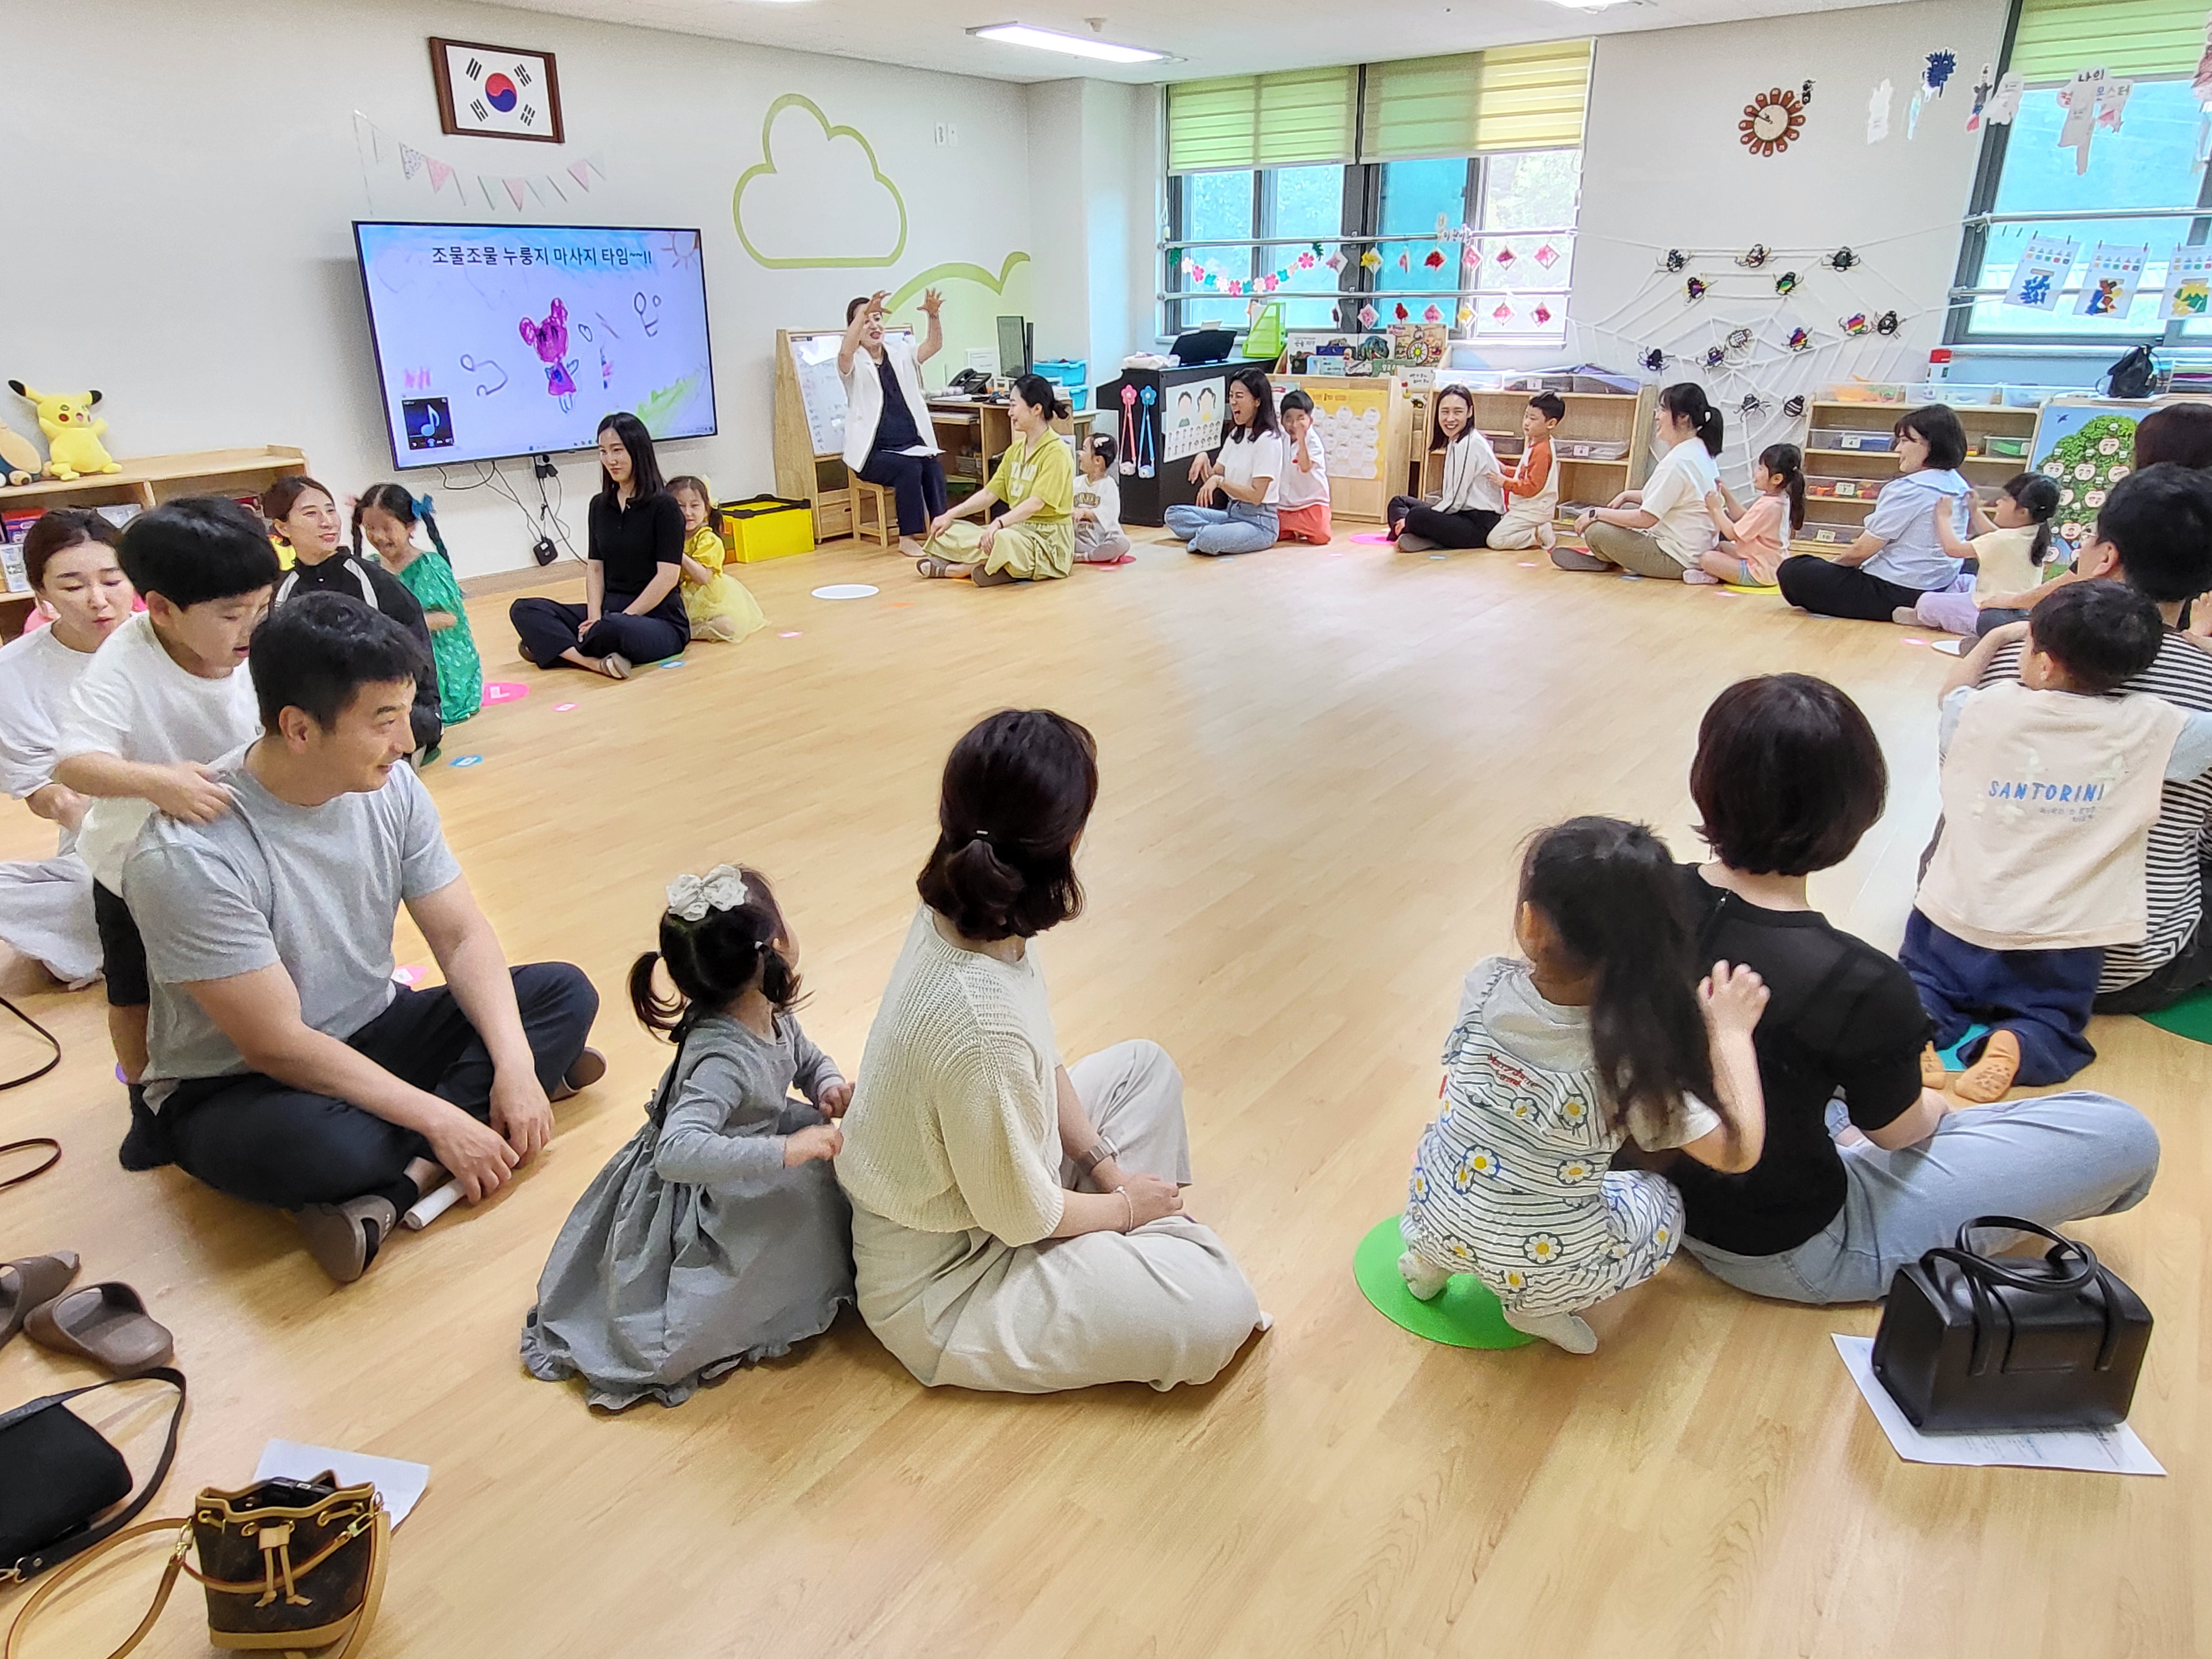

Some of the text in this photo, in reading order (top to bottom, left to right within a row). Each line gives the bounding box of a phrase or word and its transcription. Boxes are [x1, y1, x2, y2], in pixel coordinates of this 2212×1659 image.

[2078, 69, 2105, 82] 나의
[432, 246, 498, 265] 조물조물
[503, 246, 549, 265] 누룽지
[553, 246, 597, 266] 마사지
[1989, 780, 2105, 802] SANTORINI
